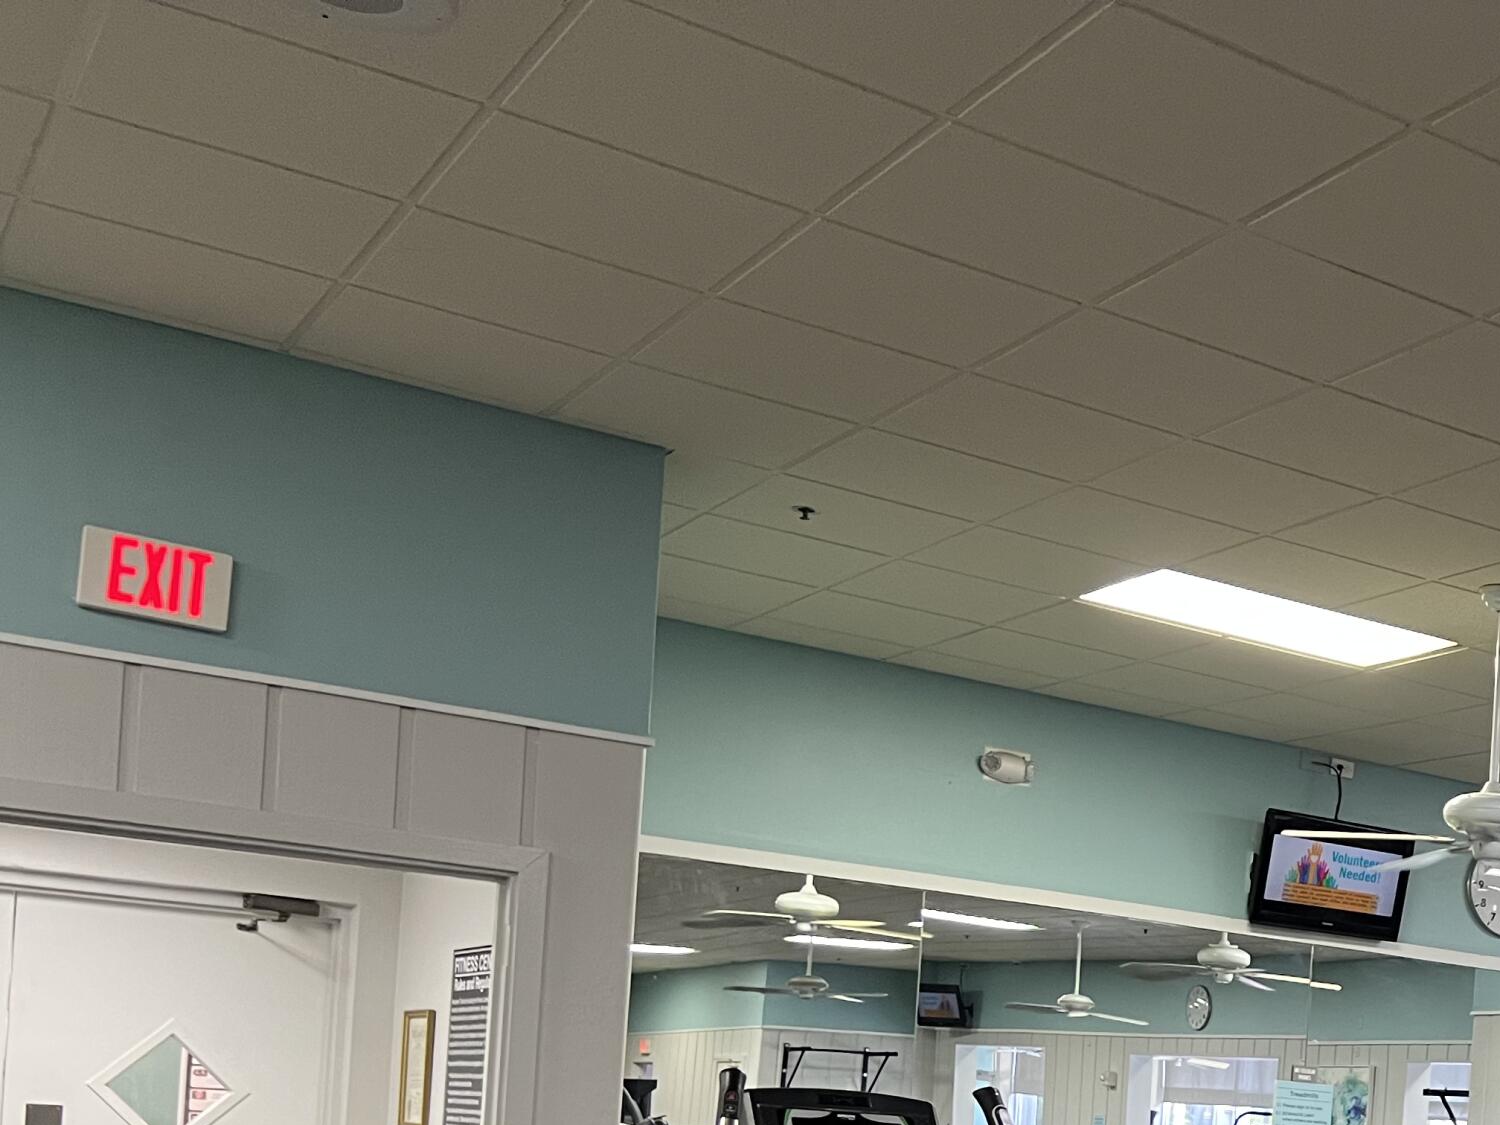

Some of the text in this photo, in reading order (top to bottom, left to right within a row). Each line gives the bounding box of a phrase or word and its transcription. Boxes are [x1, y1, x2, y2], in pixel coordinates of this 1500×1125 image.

[106, 534, 215, 619] EXIT
[1339, 867, 1382, 884] Needed!
[1478, 880, 1484, 888] 9
[1480, 898, 1486, 908] 8
[1490, 912, 1496, 921] 7
